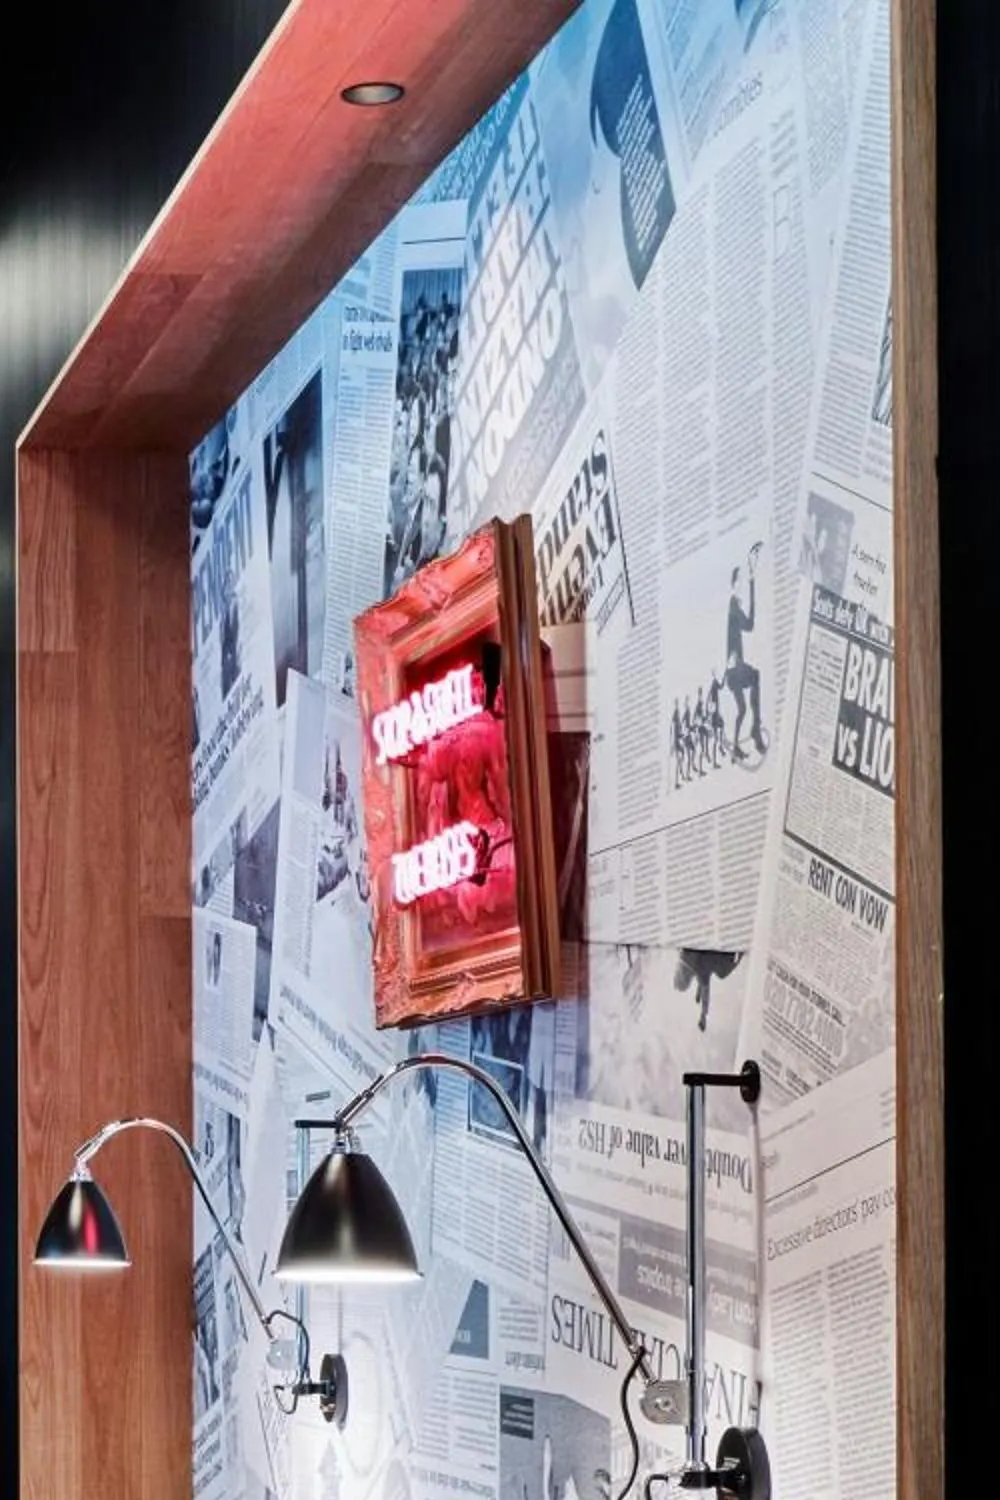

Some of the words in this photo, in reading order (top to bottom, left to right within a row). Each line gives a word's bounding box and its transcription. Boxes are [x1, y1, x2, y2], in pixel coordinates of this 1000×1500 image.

[808, 855, 835, 899] RENT
[859, 887, 889, 933] VOW
[577, 1118, 606, 1158] HS2
[607, 1125, 623, 1159] of
[625, 1127, 660, 1168] value
[702, 1147, 754, 1194] Doubt
[551, 1295, 618, 1371] TIMES
